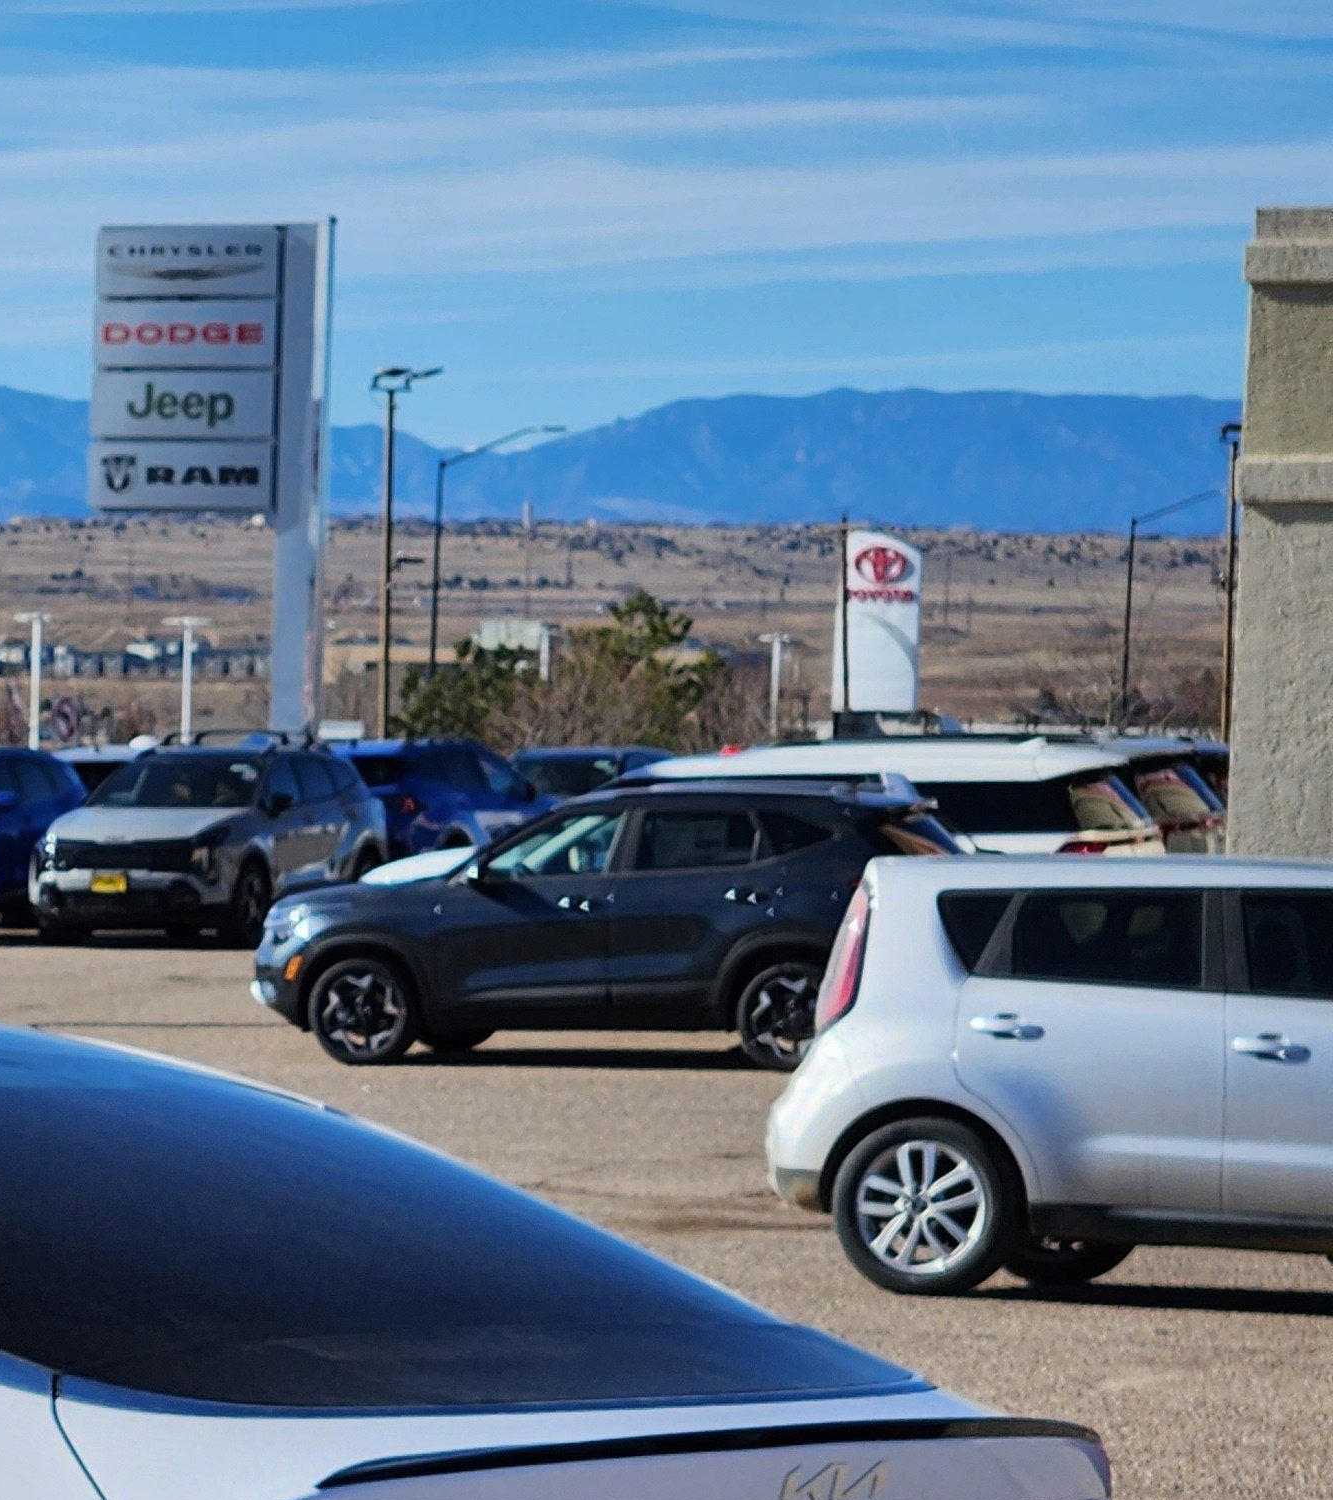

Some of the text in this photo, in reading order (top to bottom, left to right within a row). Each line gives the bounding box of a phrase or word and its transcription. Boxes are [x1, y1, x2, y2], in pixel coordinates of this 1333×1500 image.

[102, 322, 264, 345] DODGE
[127, 381, 235, 428] Jeep
[146, 466, 260, 486] RAM
